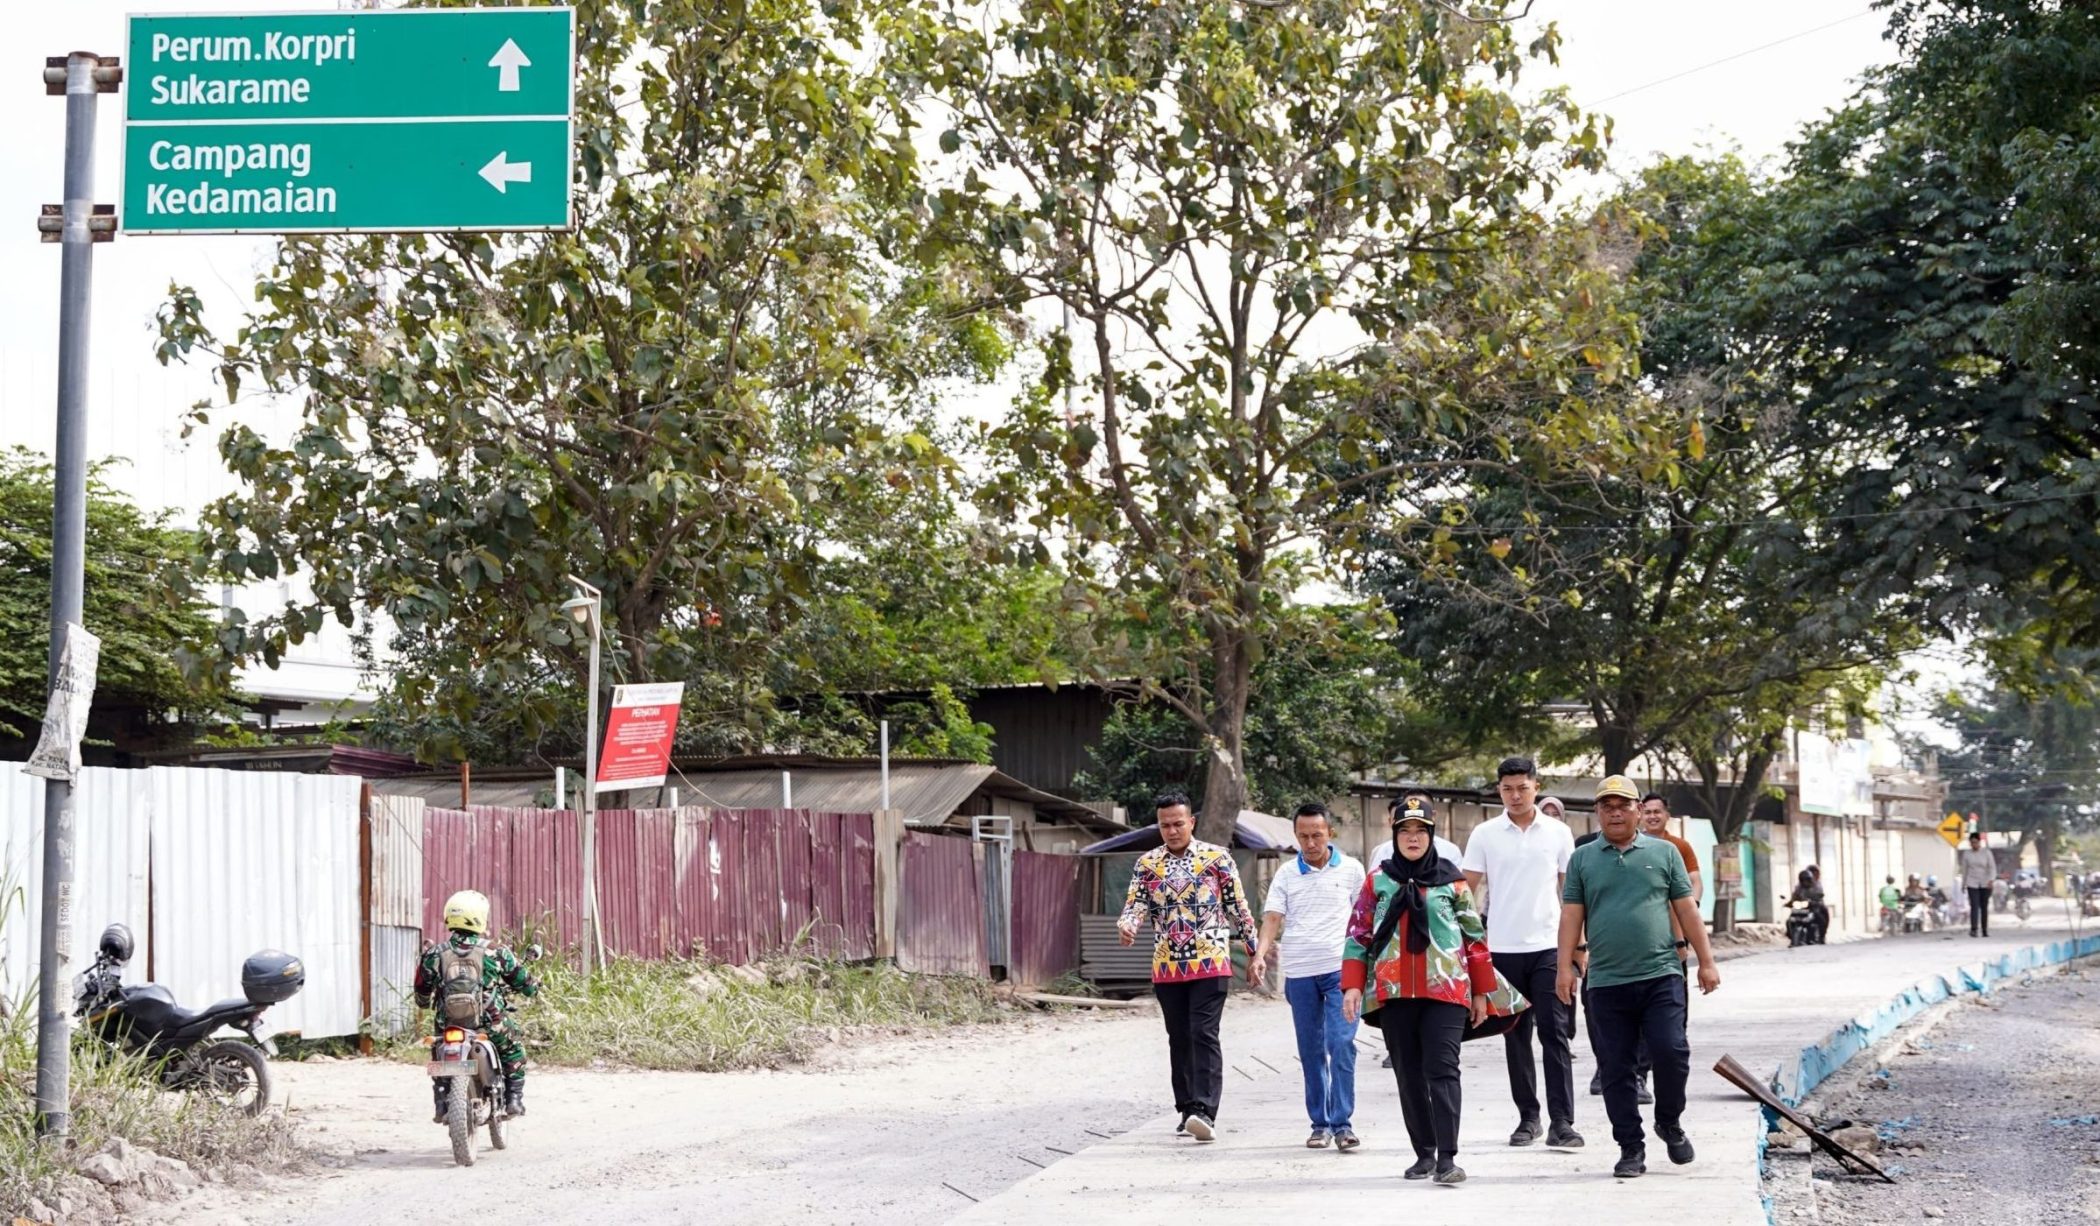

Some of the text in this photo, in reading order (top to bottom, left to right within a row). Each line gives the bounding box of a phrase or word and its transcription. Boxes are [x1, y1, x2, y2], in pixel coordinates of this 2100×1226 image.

[152, 29, 355, 65] Perum.Korpri
[151, 74, 310, 105] Sukarame
[149, 141, 311, 177] Campang
[147, 182, 336, 214] Kedamaian
[62, 884, 70, 896] WC
[61, 898, 70, 922] SEDOT
